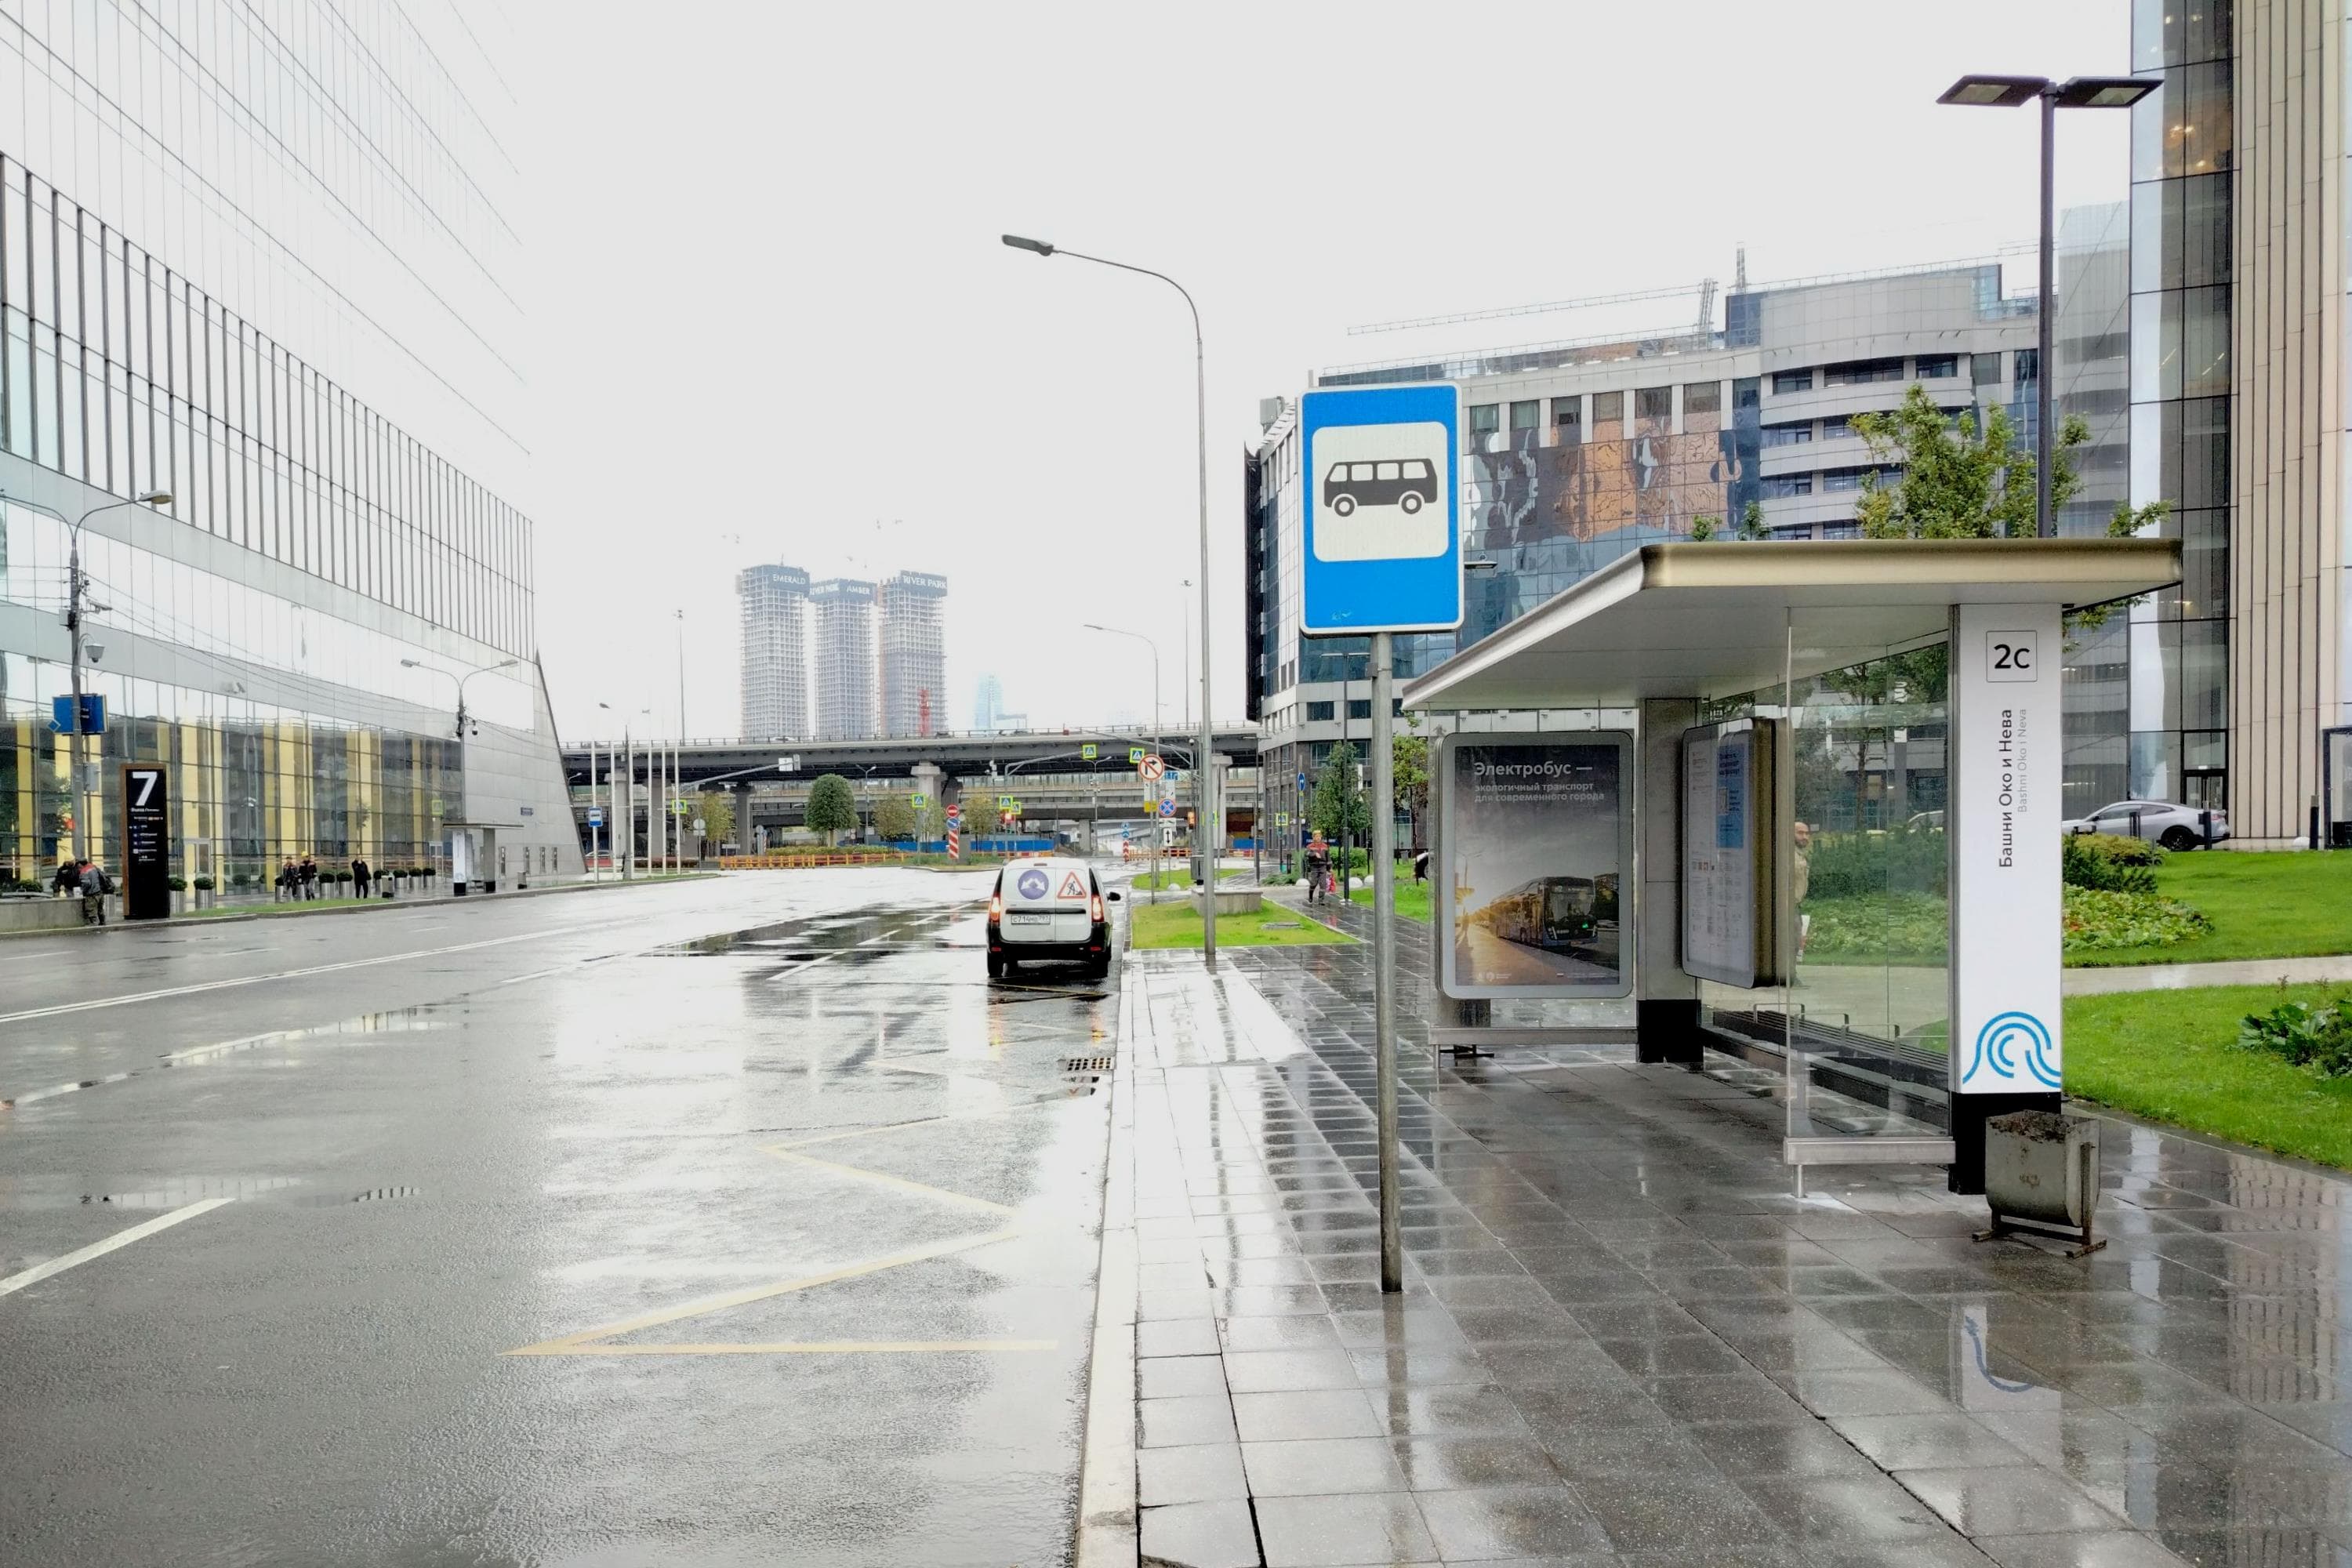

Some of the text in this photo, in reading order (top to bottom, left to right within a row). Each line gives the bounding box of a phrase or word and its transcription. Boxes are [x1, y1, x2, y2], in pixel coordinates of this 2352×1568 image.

[773, 574, 806, 585] EMERALD
[902, 575, 946, 590] RIVER PARK
[847, 585, 870, 595] AMBER
[2017, 709, 2027, 738] Neva
[2017, 748, 2027, 771] Oko
[1474, 760, 1572, 779] Электробус
[132, 771, 158, 806] 7
[1475, 782, 1594, 793] экологичный транспорт
[1998, 710, 2013, 868] Башни Око и Нева
[2017, 775, 2027, 812] Bashni
[1475, 792, 1605, 804] для современного города
